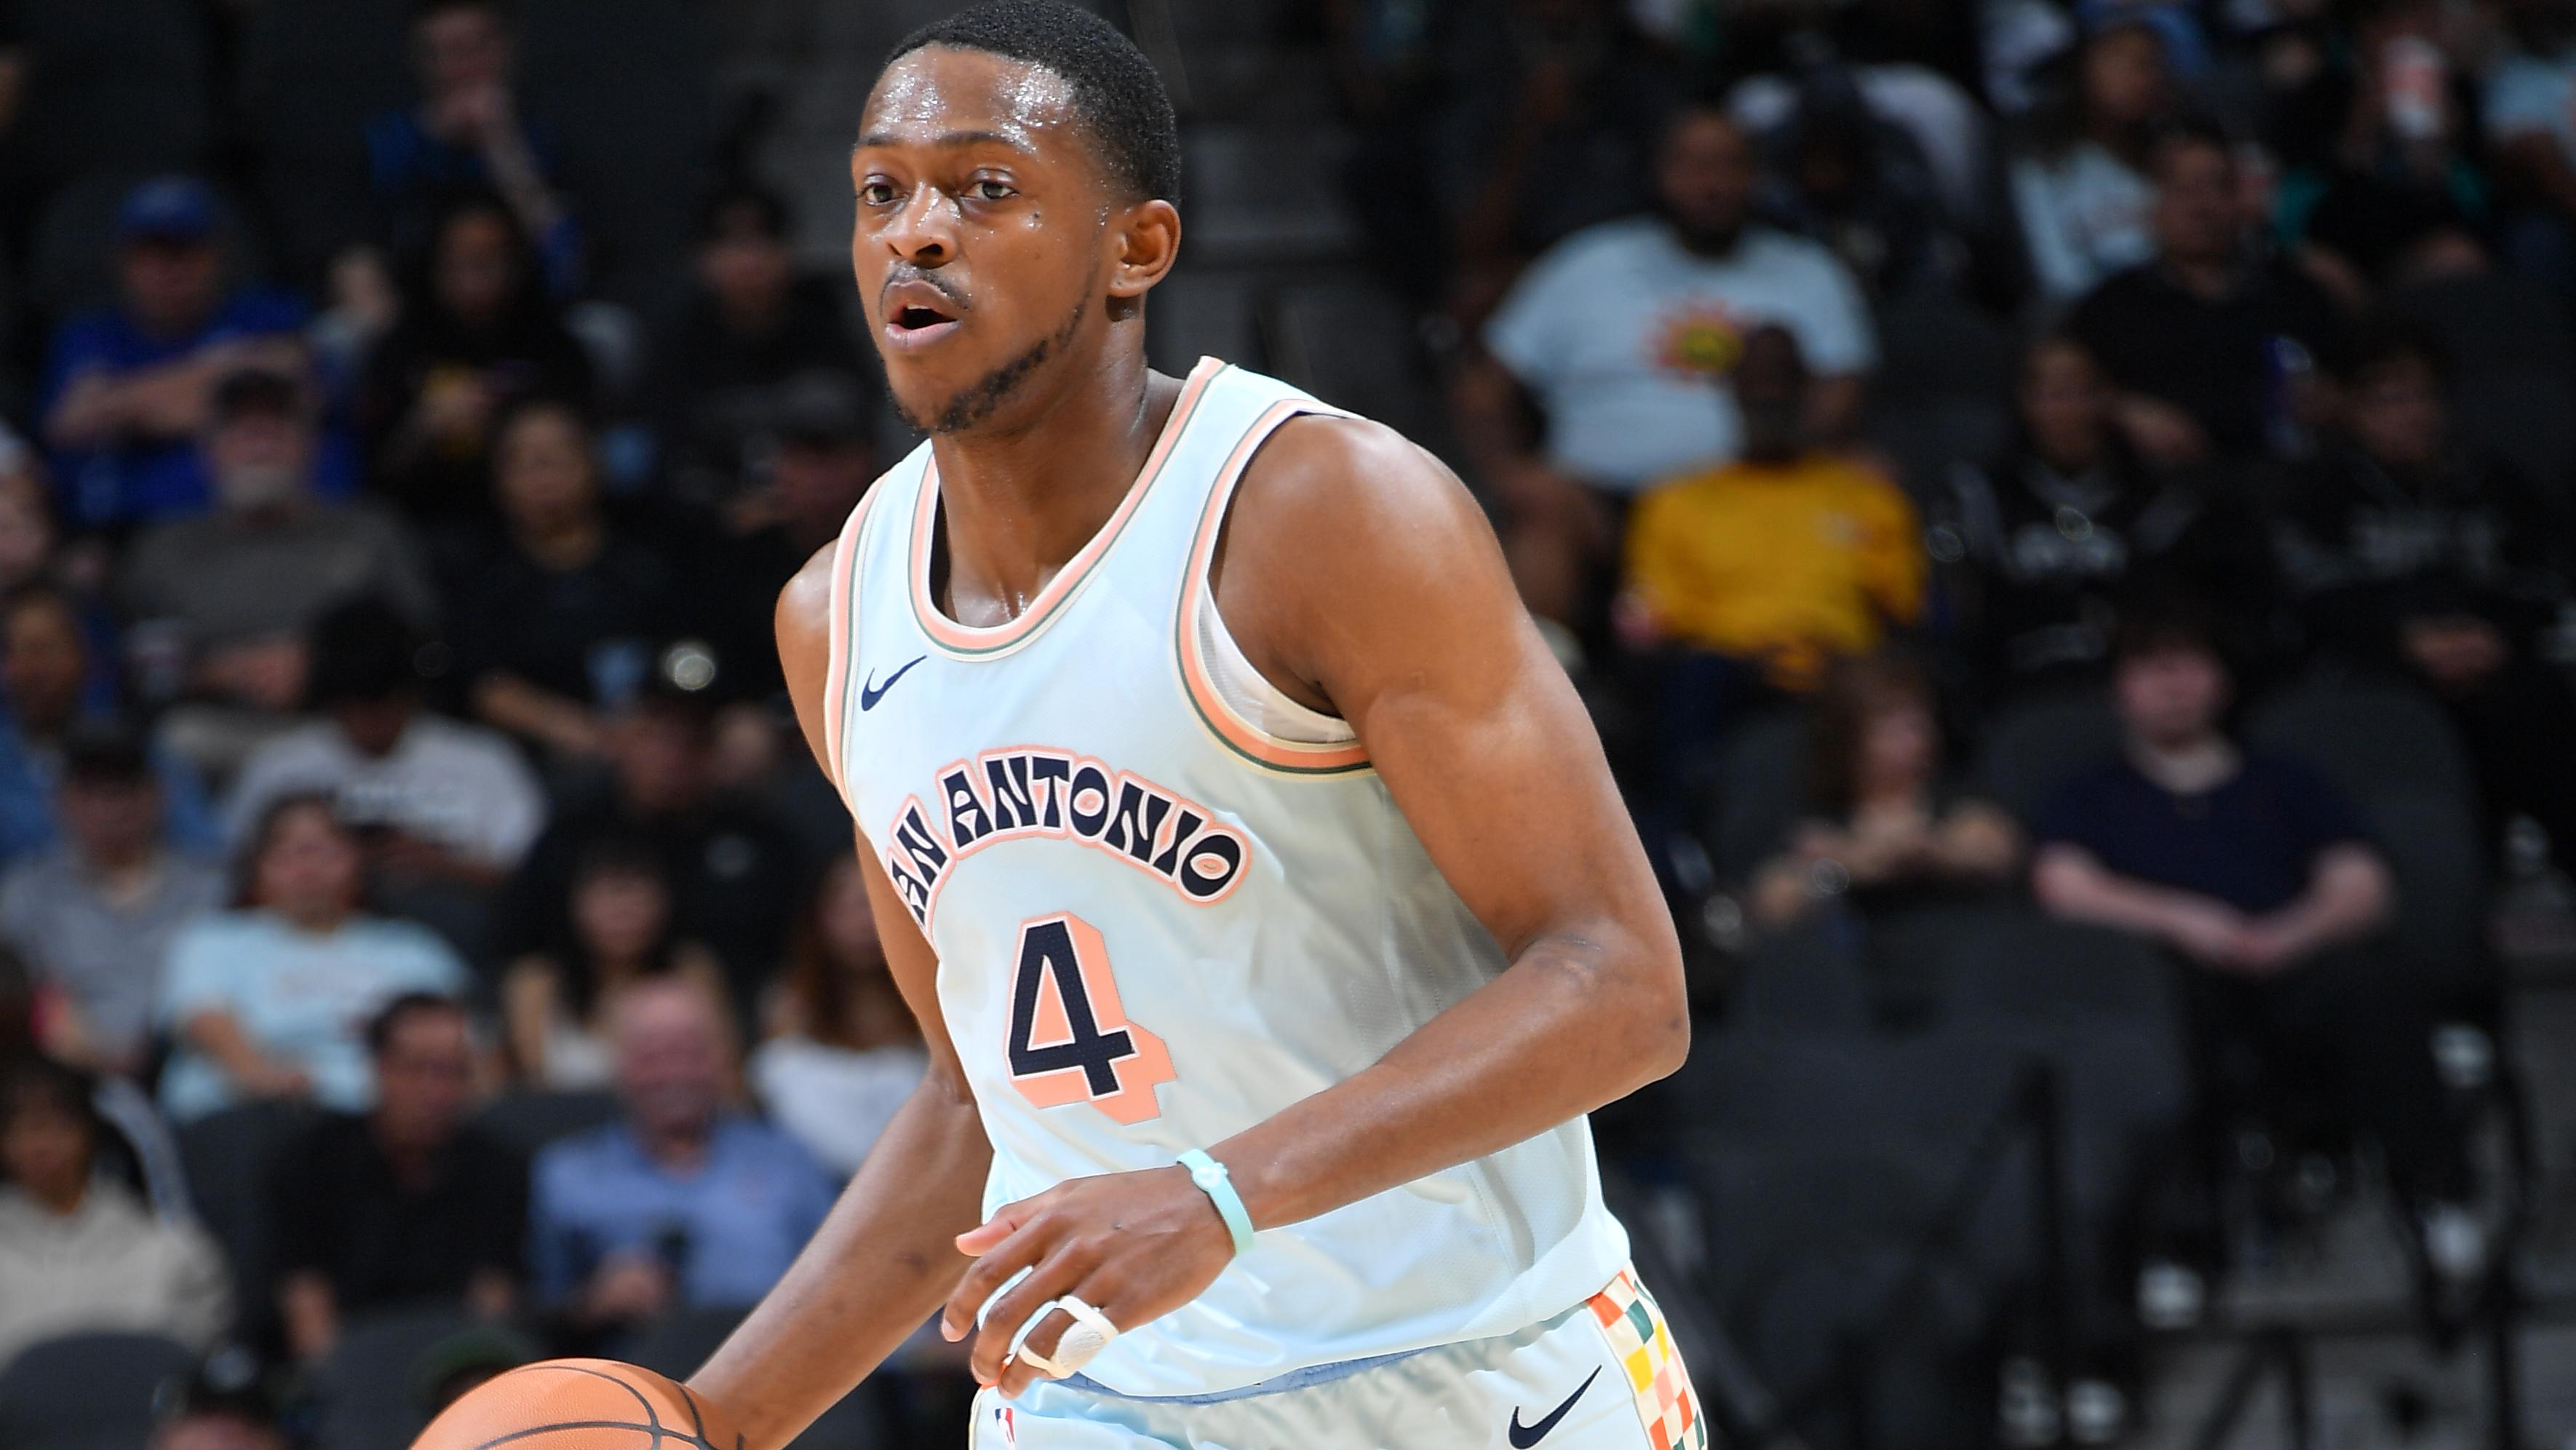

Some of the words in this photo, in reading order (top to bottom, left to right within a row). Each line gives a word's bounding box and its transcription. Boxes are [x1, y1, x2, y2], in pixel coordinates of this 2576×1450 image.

[889, 802, 950, 929] AN
[940, 753, 1244, 900] ANTONIO
[1004, 916, 1140, 1101] 4
